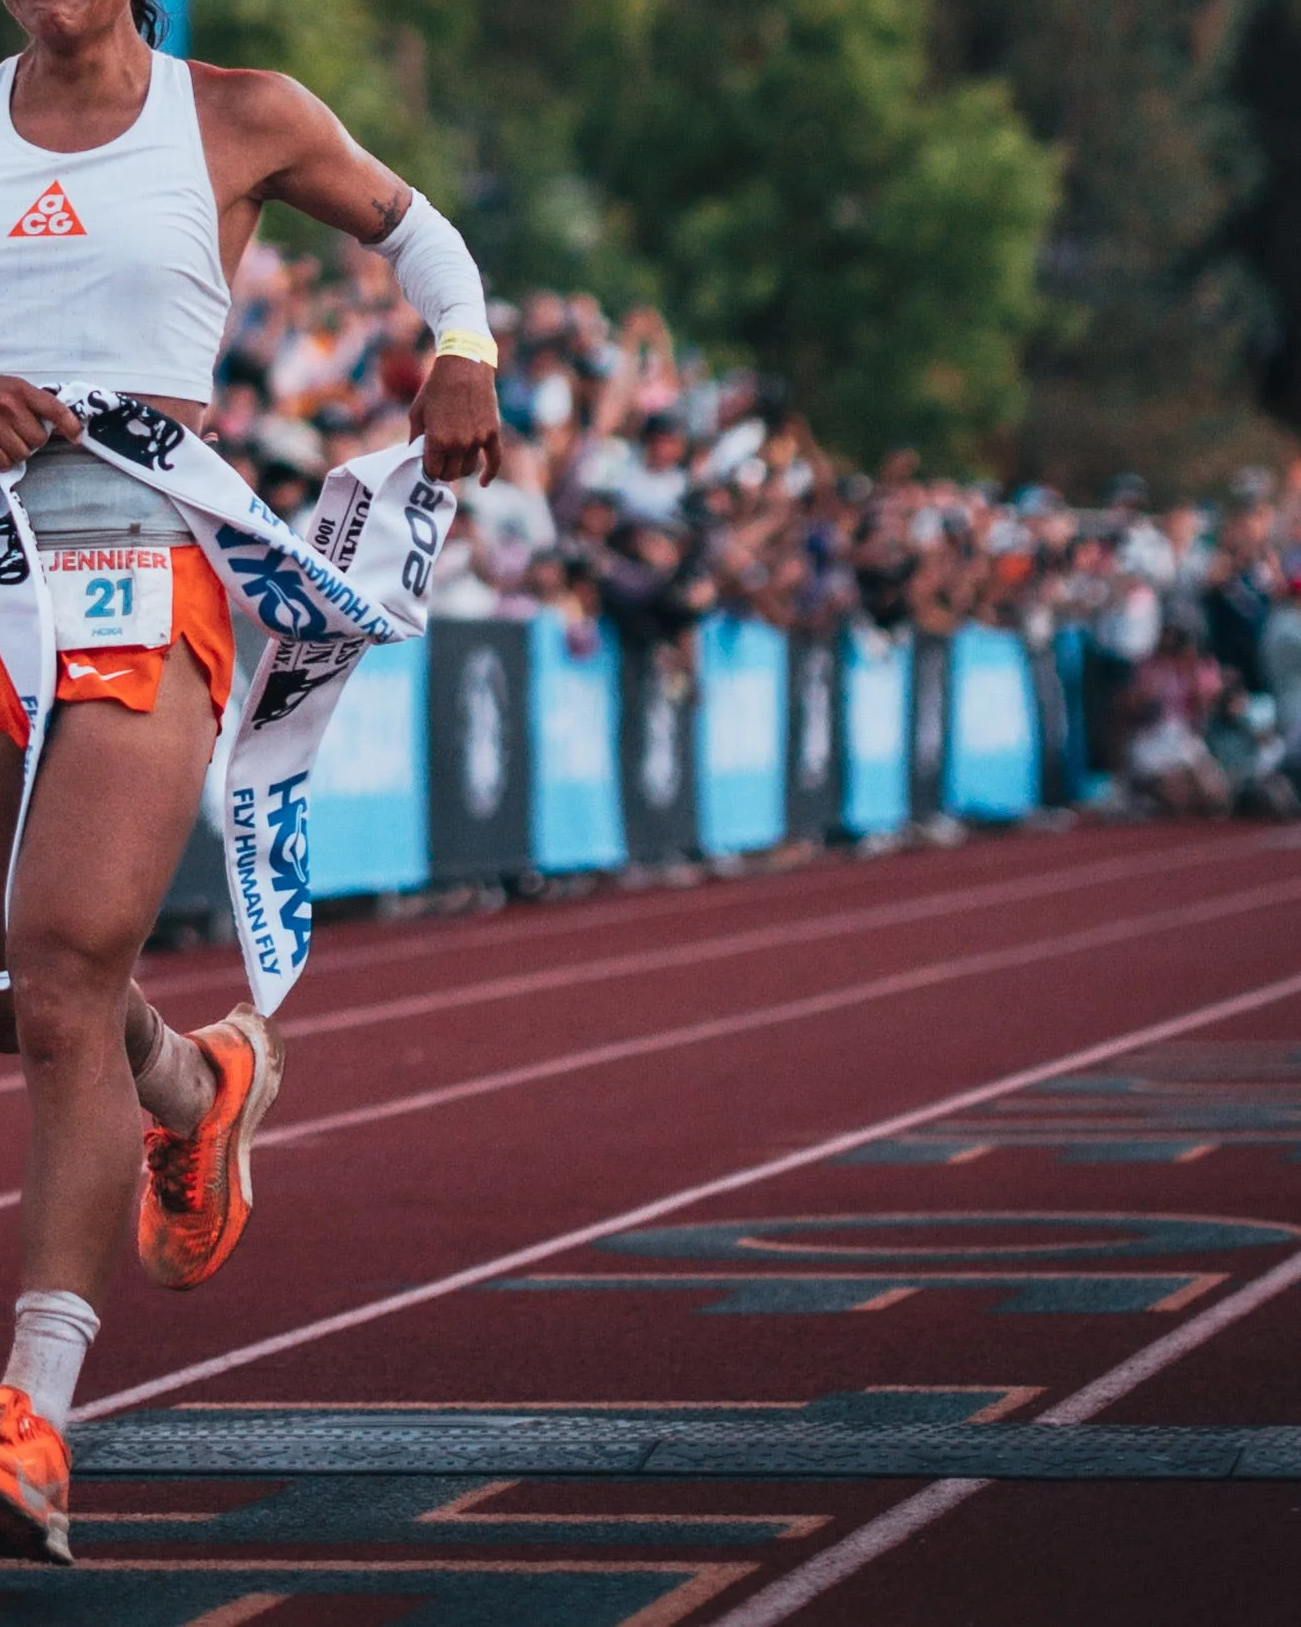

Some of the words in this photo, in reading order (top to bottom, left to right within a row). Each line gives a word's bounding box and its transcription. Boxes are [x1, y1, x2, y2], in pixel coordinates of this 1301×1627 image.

[314, 516, 336, 547] 100
[48, 549, 168, 572] JENNIFER
[84, 577, 134, 619] 21
[232, 787, 256, 829] FLY
[234, 833, 268, 933] HUMAN
[255, 933, 282, 975] FLY
